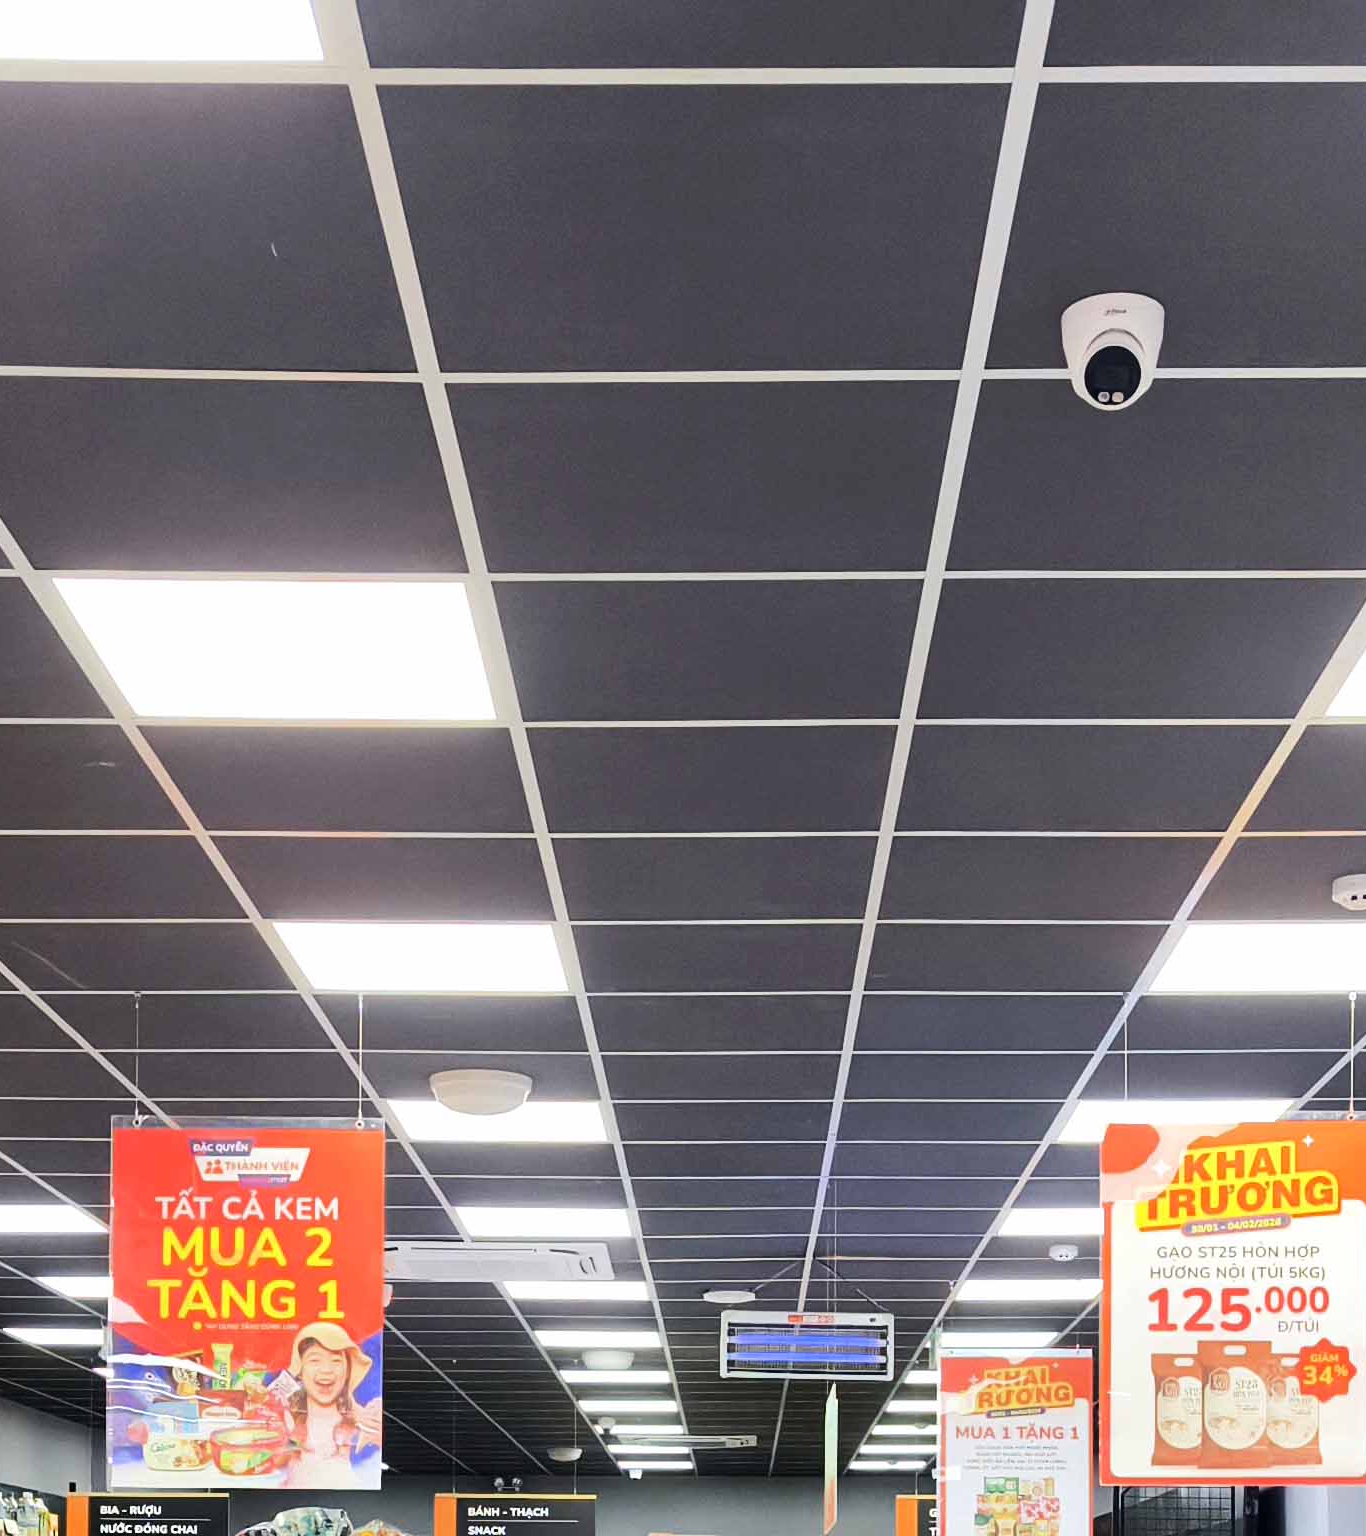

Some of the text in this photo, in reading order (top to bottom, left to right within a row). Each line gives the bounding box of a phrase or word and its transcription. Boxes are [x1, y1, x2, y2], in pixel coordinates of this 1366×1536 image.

[1183, 1146, 1293, 1185] KHAI
[154, 1188, 339, 1221] TẤT CẢ KEM
[1145, 1175, 1334, 1222] TRƯƠNG
[162, 1227, 334, 1268] MUA 2
[1198, 1246, 1237, 1258] ST25
[1289, 1266, 1326, 1281] 5KG)
[147, 1266, 345, 1331] TẶNG 1
[1147, 1286, 1330, 1332] 125.000
[1303, 1364, 1348, 1385] 34%
[955, 1426, 996, 1440] MUA
[1002, 1426, 1012, 1440] 1
[1070, 1426, 1080, 1440] 1
[99, 1505, 119, 1516] BIA
[467, 1504, 549, 1520] BÁNH THẠCH
[170, 1523, 198, 1535] CHAI
[467, 1525, 506, 1536] SNACK
